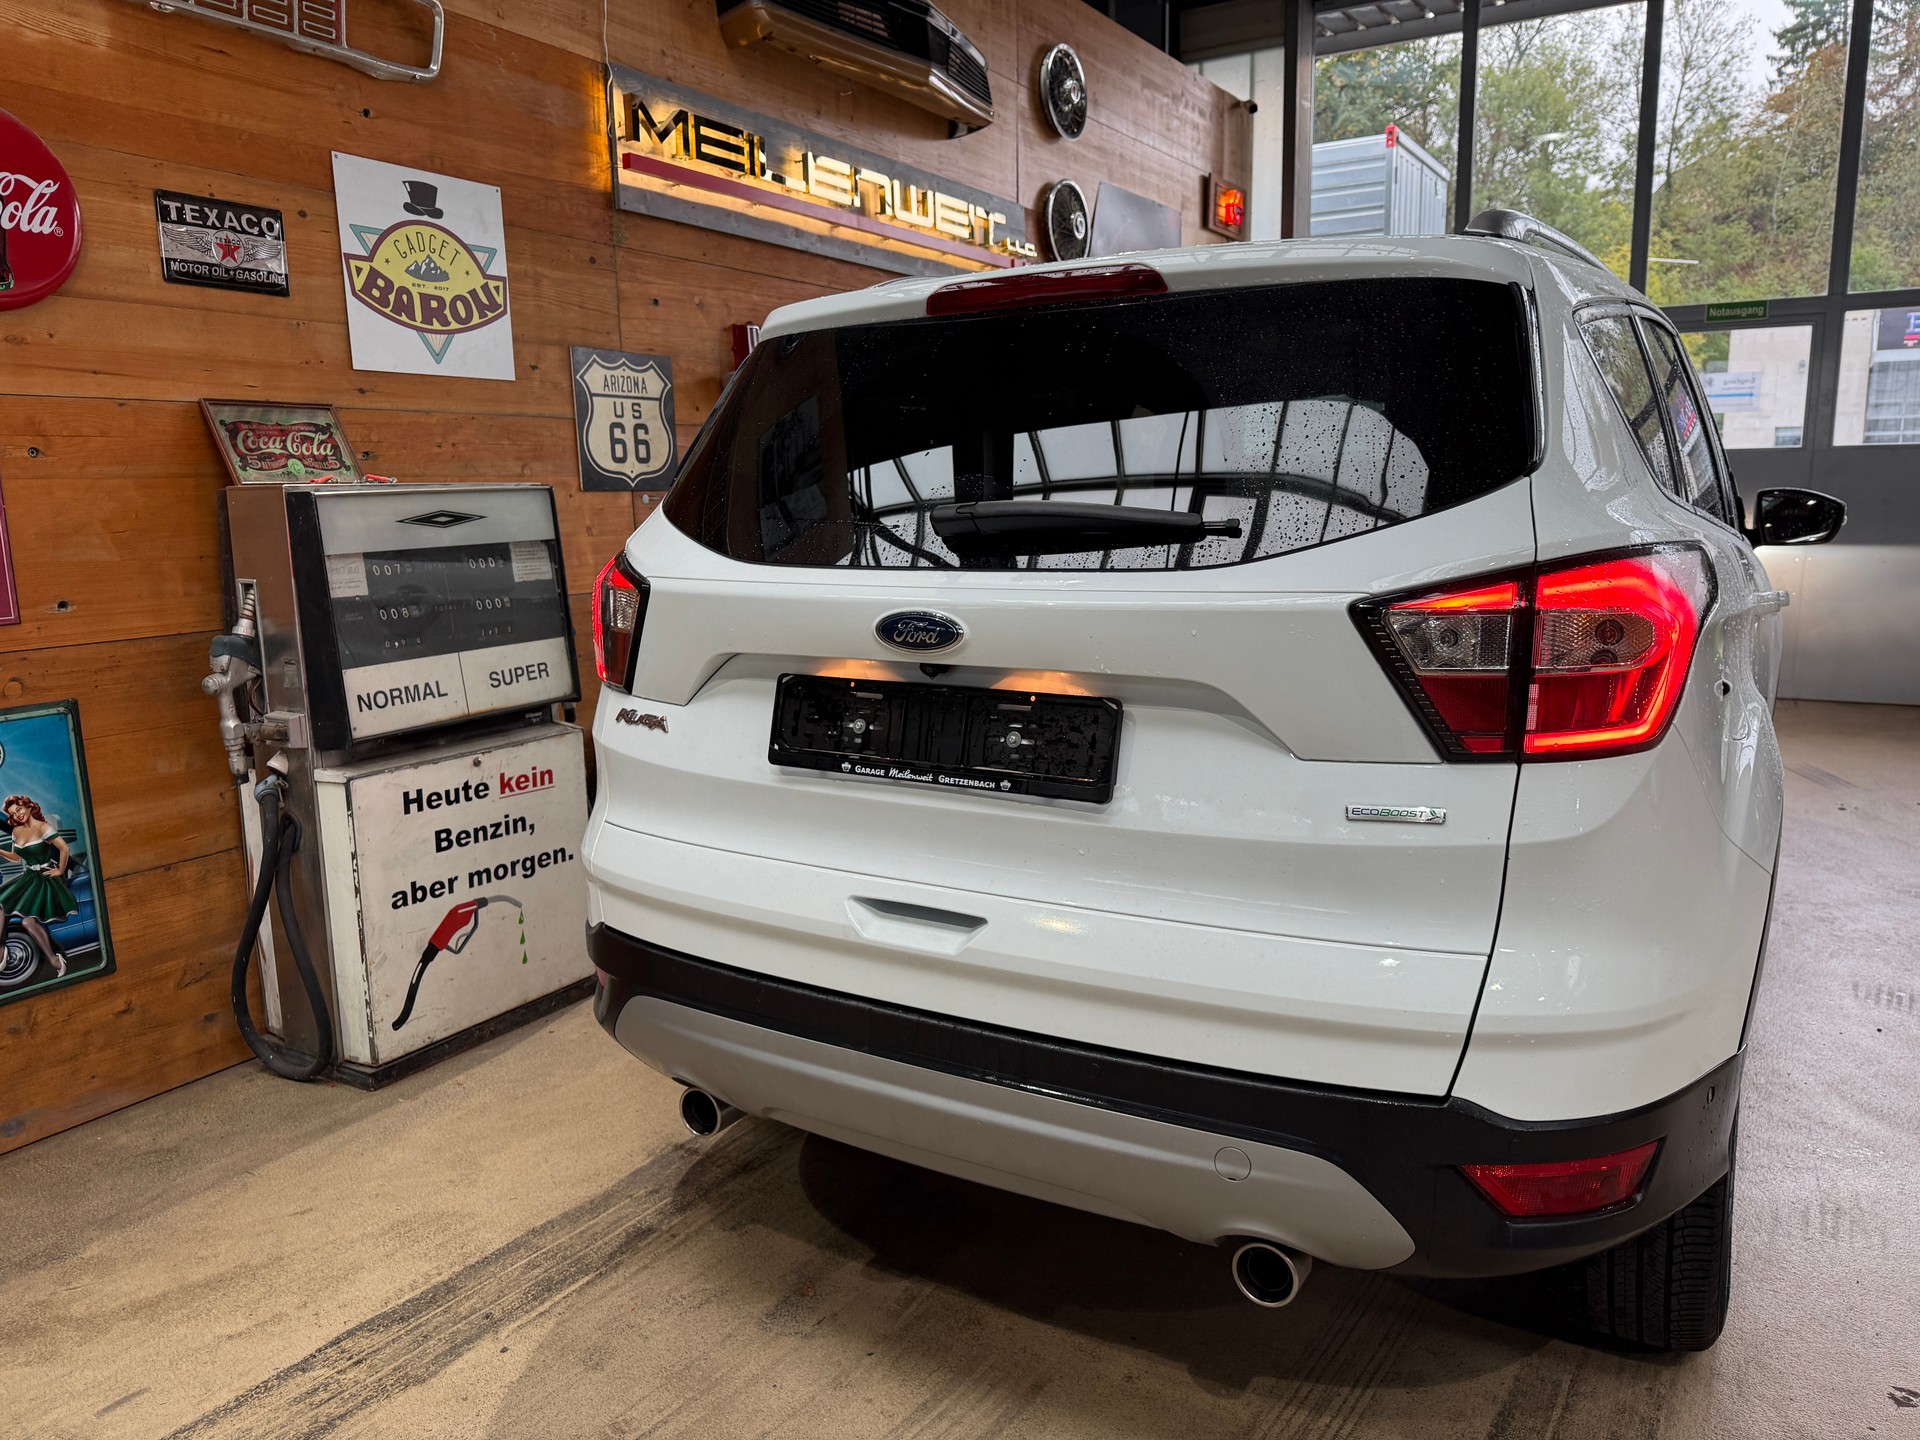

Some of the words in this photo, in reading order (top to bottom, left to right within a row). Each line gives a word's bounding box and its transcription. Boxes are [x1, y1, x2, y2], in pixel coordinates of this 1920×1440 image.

[162, 200, 280, 237] TEXACO
[393, 231, 461, 266] GADGET
[170, 260, 210, 275] MOTOR
[211, 266, 229, 278] OIL
[235, 269, 287, 286] GASOLINE
[411, 282, 429, 290] EST.
[357, 264, 503, 328] BARON
[1708, 304, 1765, 317] Notausgang
[603, 374, 648, 394] ARIZONA
[608, 421, 652, 465] 66
[893, 619, 940, 644] Ford
[488, 661, 550, 689] SUPER
[356, 680, 449, 713] NORMAL
[402, 779, 491, 815] Heute
[499, 766, 555, 796] kein
[854, 764, 886, 776] GARAGE
[888, 766, 934, 782] Meilenweit
[938, 774, 996, 789] GRETZENBACH
[434, 813, 536, 853] Benzin,
[391, 875, 459, 910] aber
[468, 847, 575, 889] morgen.
